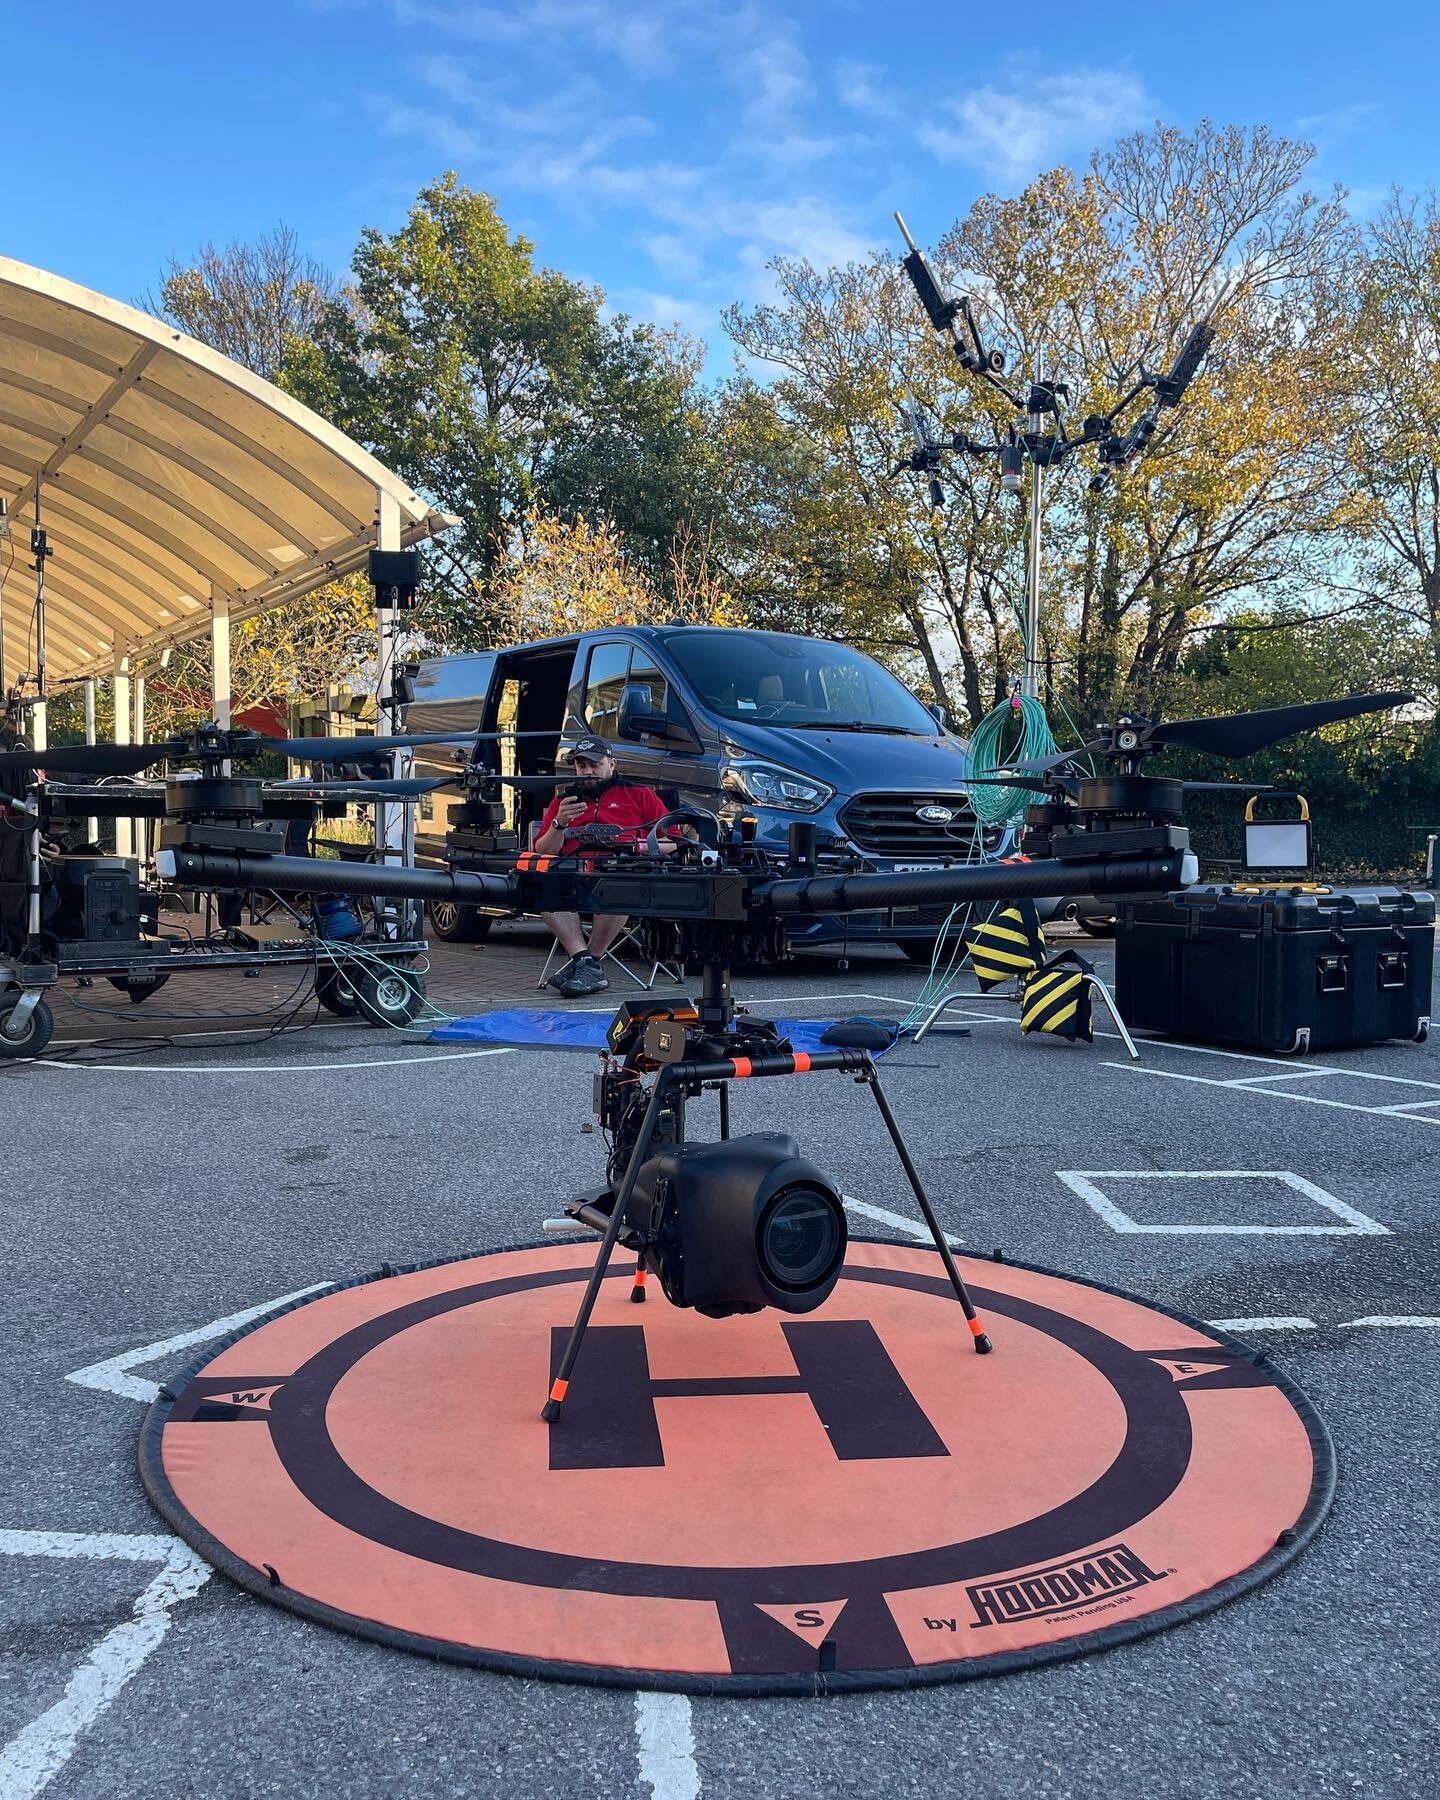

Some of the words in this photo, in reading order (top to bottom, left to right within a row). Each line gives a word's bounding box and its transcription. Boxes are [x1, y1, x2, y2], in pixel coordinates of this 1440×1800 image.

[925, 807, 948, 819] Ford
[1174, 1364, 1198, 1373] E
[232, 1392, 267, 1403] W
[548, 1320, 952, 1470] H
[794, 1609, 823, 1627] S
[1045, 1612, 1078, 1625] Patent
[1079, 1602, 1118, 1618] Pending
[1114, 1595, 1136, 1606] USA
[924, 1616, 957, 1632] by
